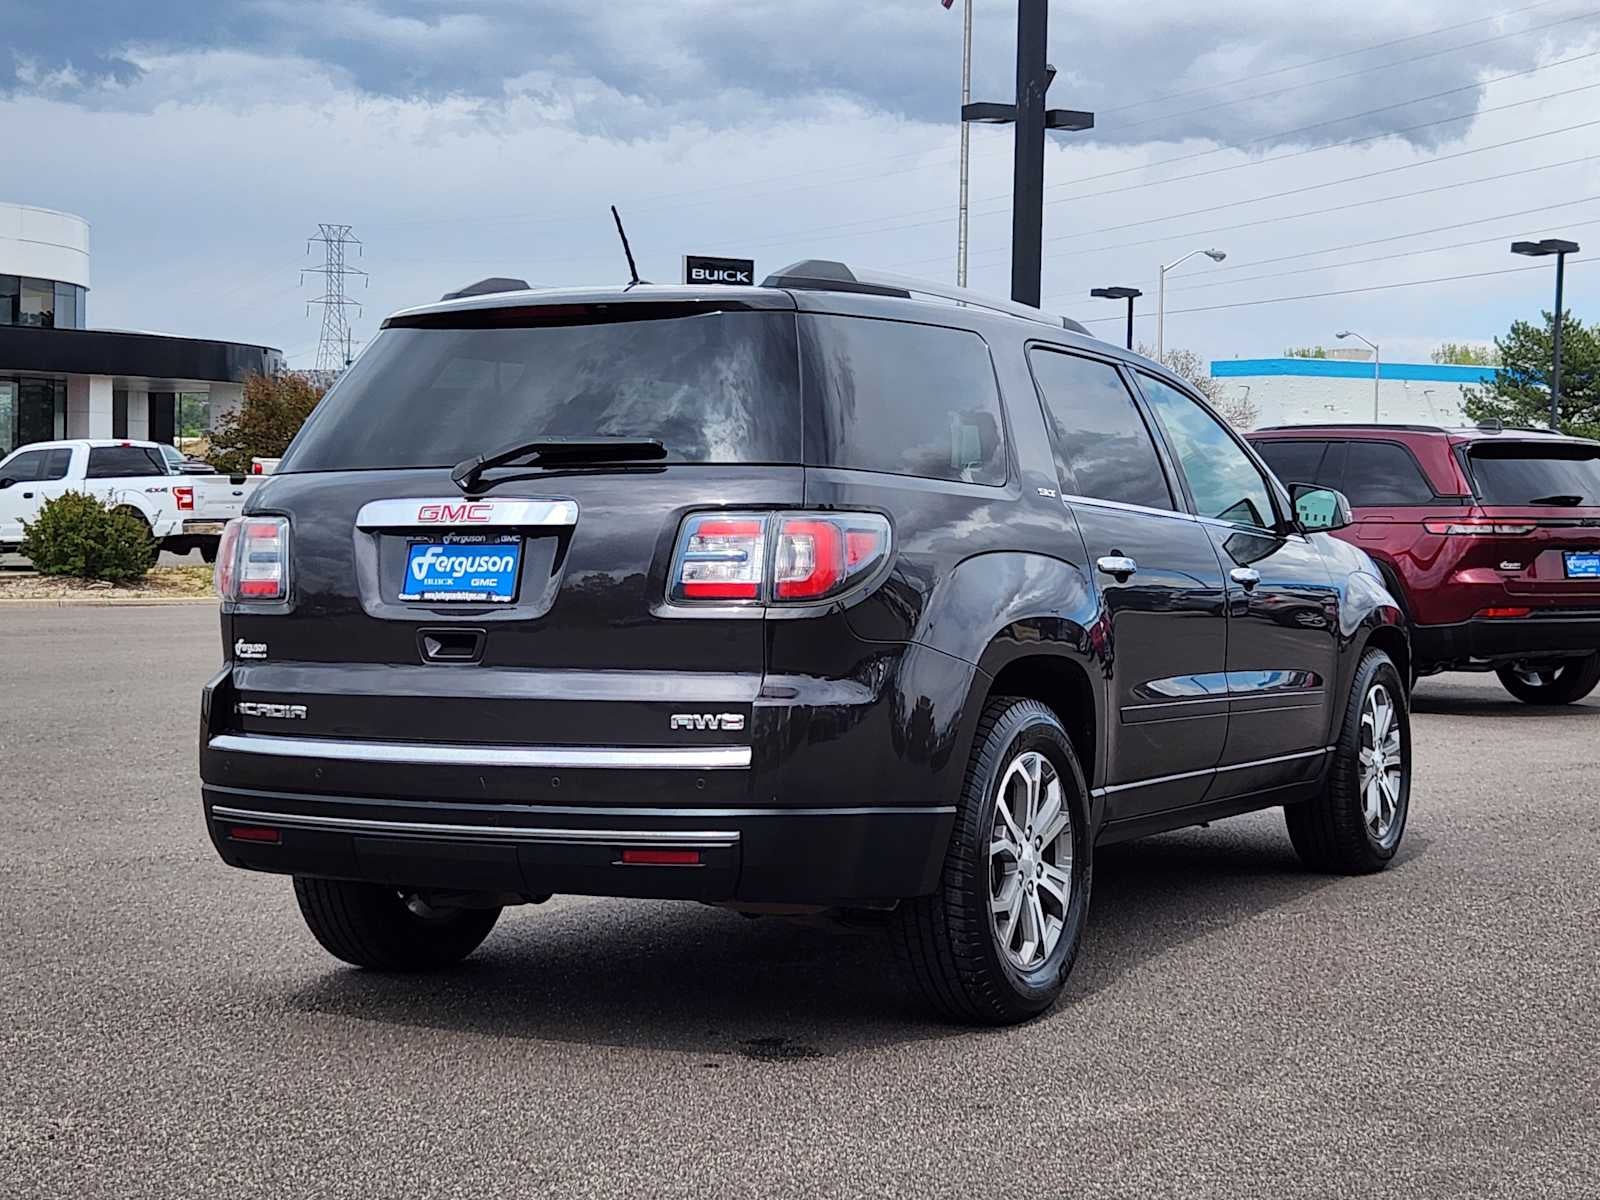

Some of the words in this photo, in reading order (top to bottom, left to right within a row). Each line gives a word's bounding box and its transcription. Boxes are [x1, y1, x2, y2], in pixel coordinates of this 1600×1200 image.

[691, 268, 750, 283] BUICK
[417, 504, 494, 523] GMC
[411, 547, 514, 580] Ferguson
[424, 578, 454, 586] BUICK
[471, 578, 498, 587] GMC
[670, 713, 745, 730] AWD
